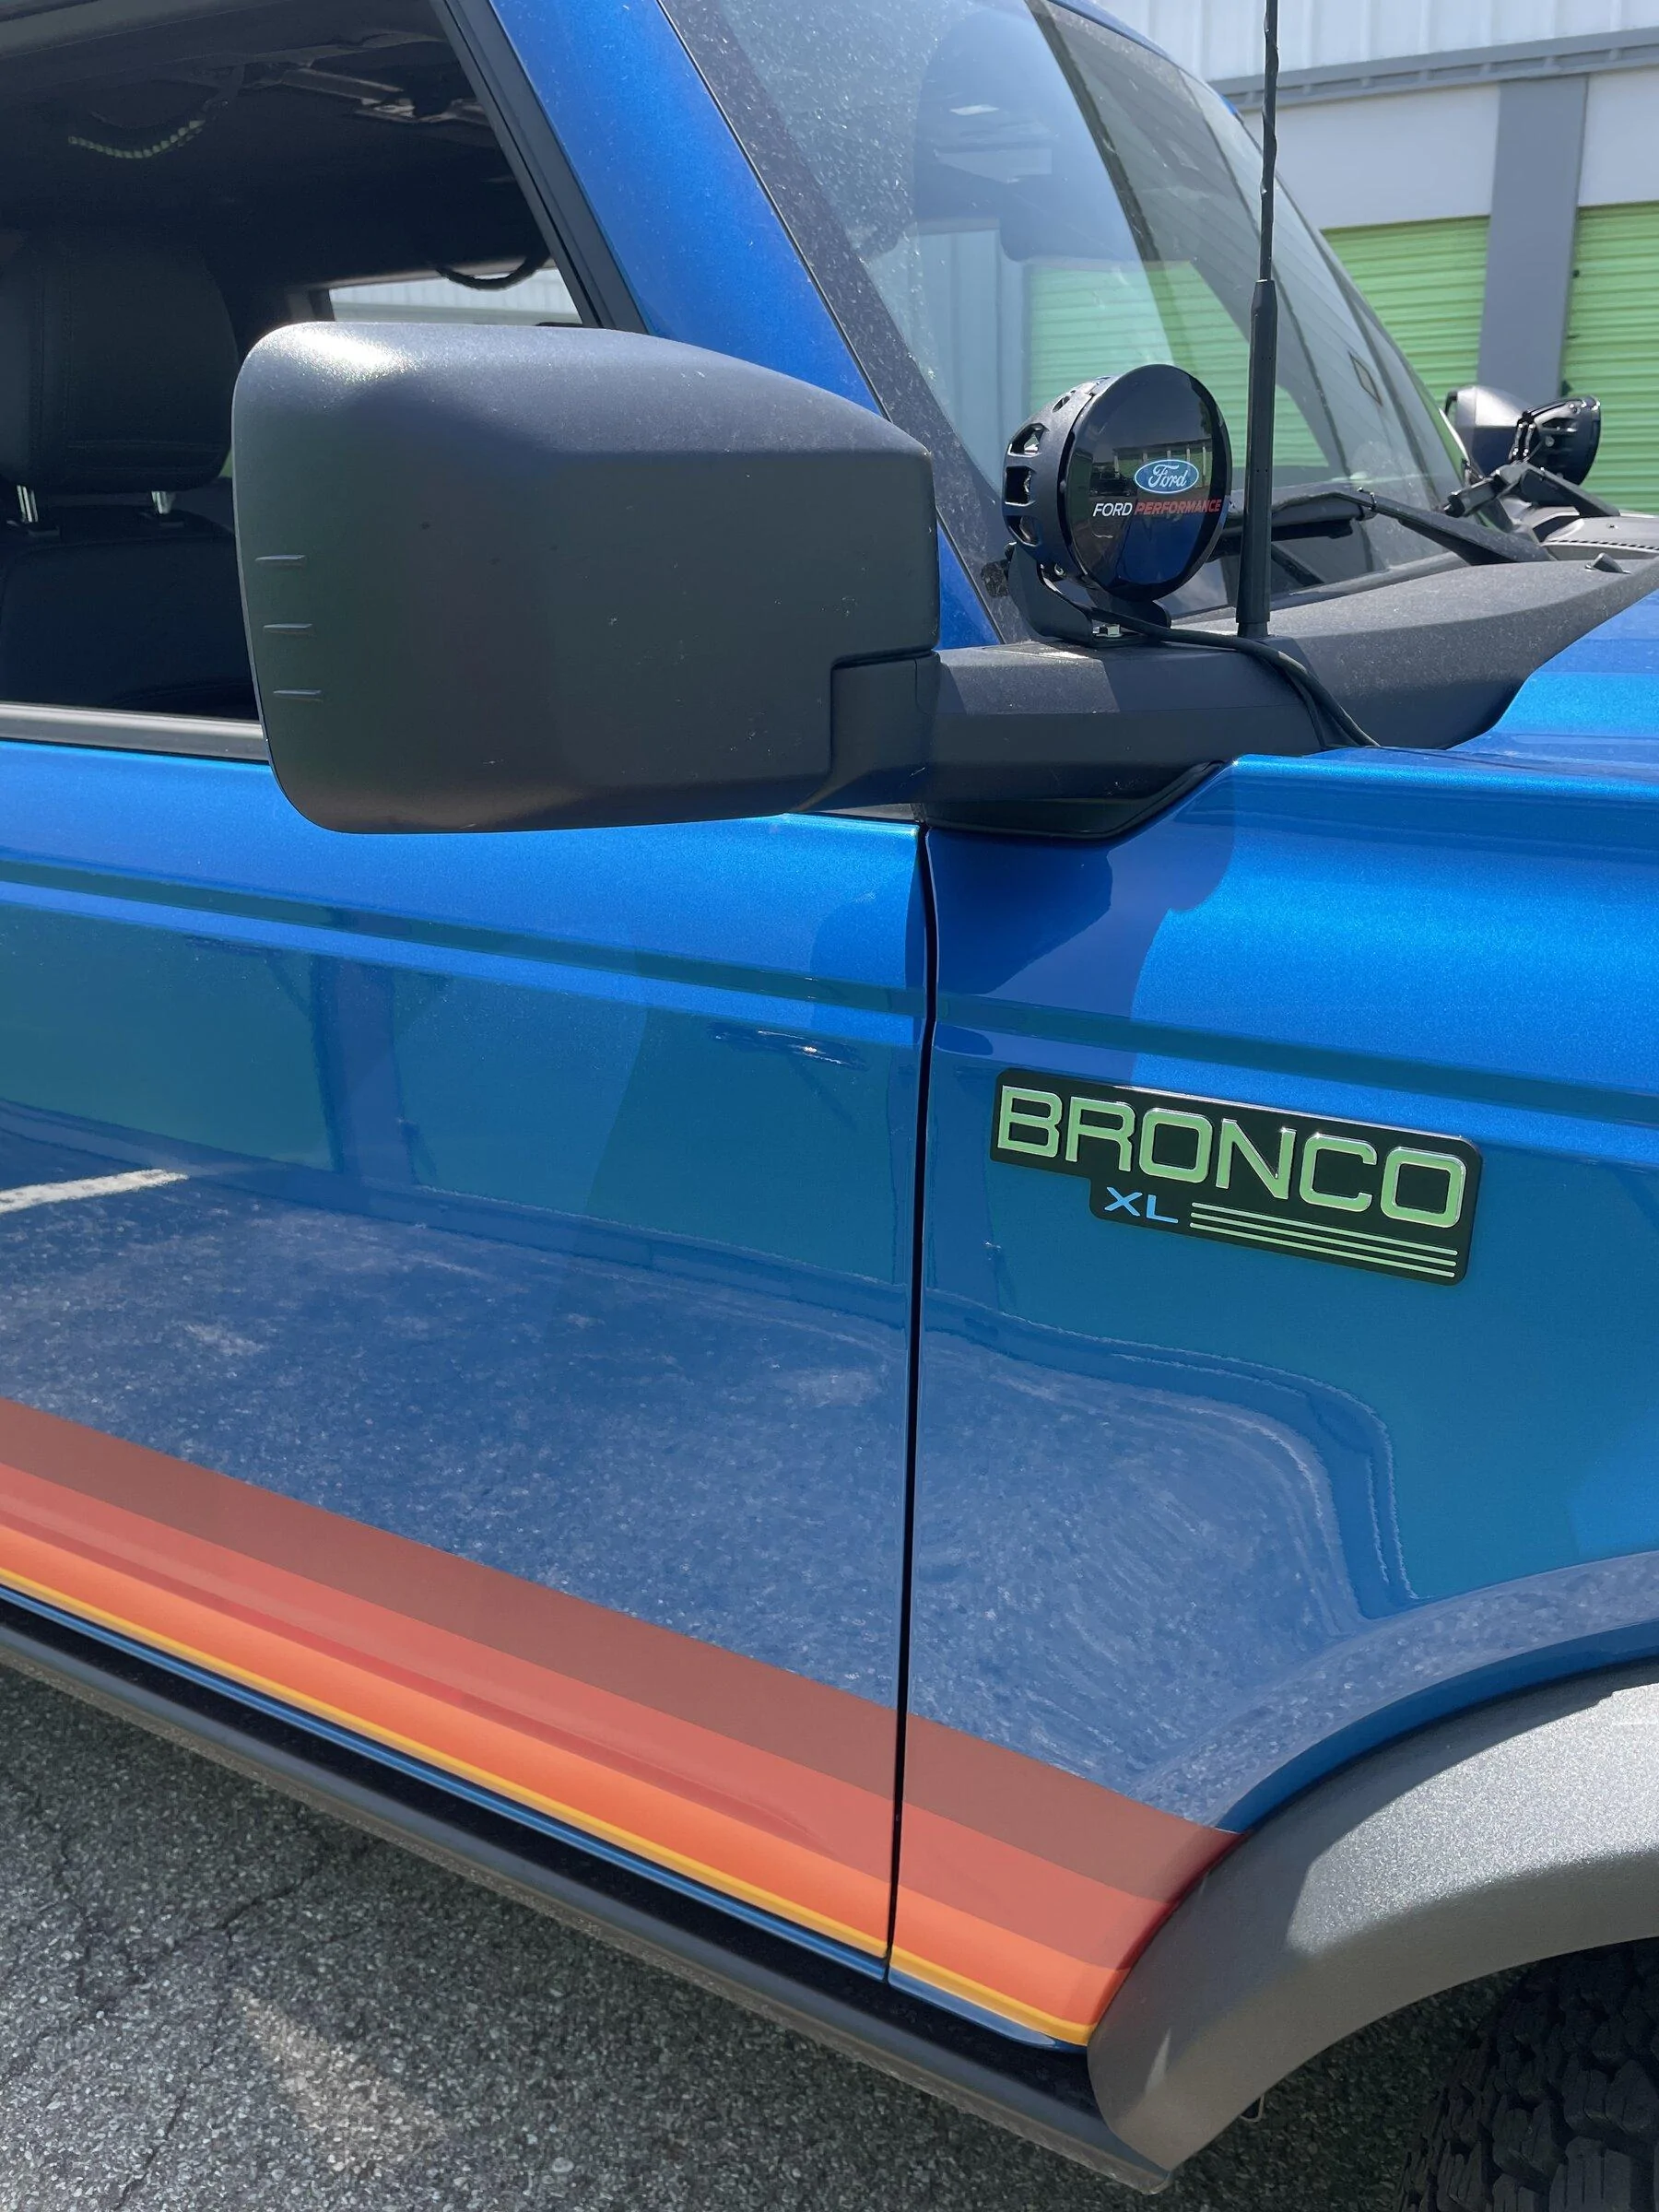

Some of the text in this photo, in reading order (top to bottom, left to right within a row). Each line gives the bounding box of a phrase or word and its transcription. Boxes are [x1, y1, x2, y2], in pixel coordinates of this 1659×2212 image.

[1148, 465, 1187, 488] Ford
[1092, 500, 1220, 517] FORD PERFORMANCE
[997, 1085, 1467, 1229] BRONCO
[1103, 1186, 1179, 1224] XL
